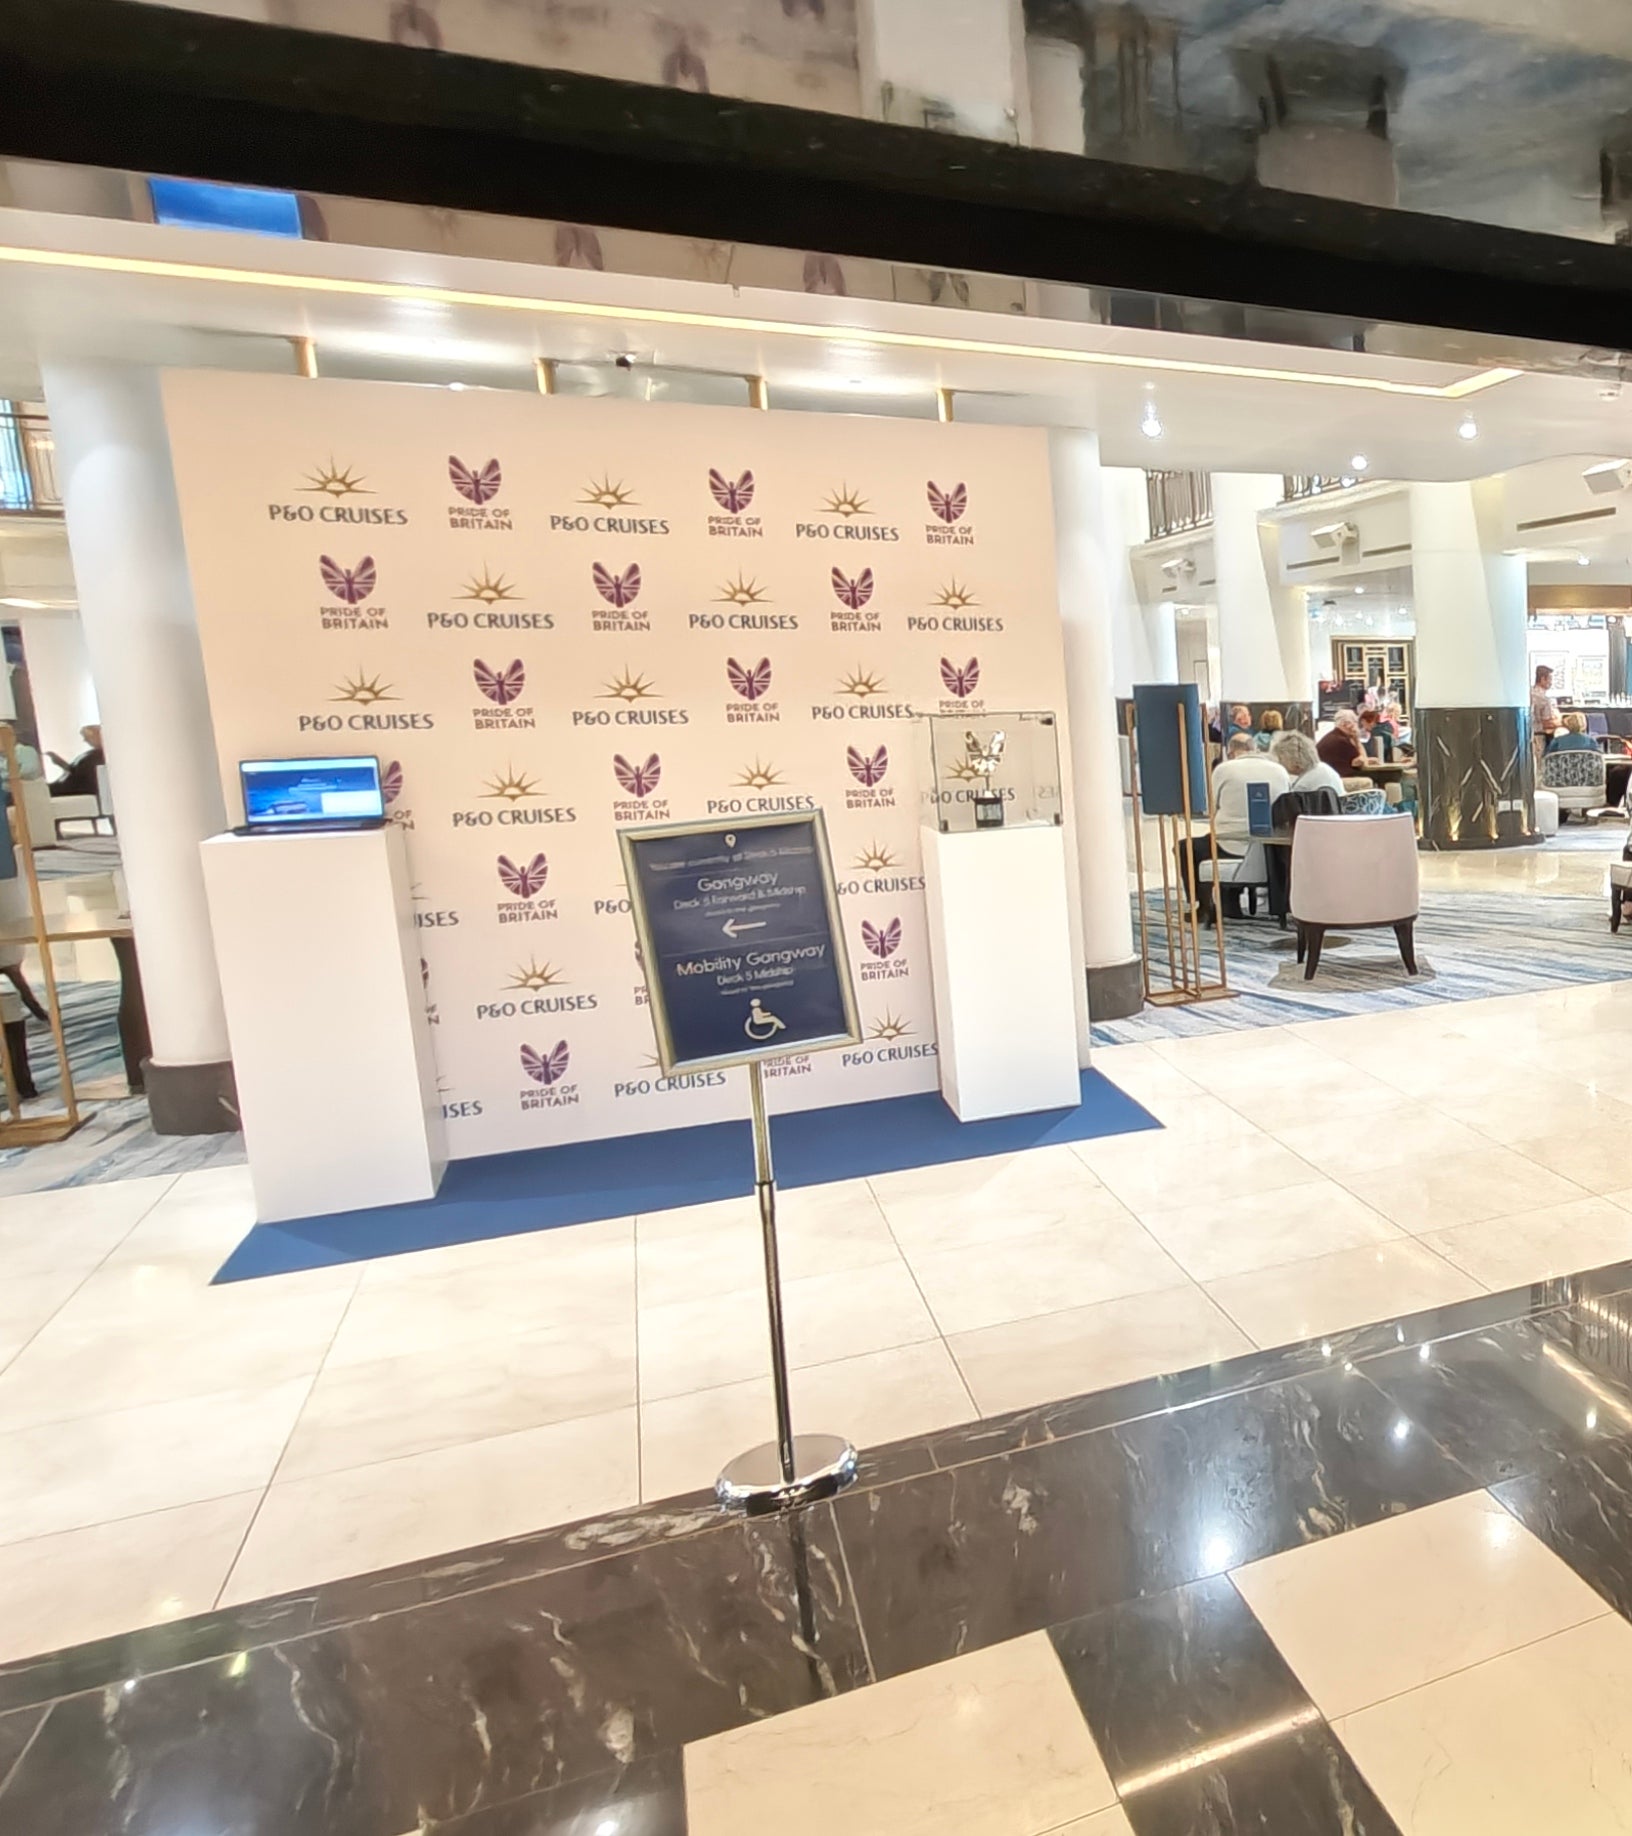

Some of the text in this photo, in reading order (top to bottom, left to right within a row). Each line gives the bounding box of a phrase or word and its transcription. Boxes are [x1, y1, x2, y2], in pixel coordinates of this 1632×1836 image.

[268, 504, 408, 526] P&O CRUISES
[448, 507, 510, 519] PRIDE OF
[449, 517, 513, 530] BRITAIN
[550, 515, 670, 535] P&O CRUISES
[708, 516, 761, 527] PRIDE OF
[708, 525, 763, 538] BRITAIN
[796, 523, 900, 542] P&O CRUISES
[926, 525, 972, 535] PRIDE OF
[926, 534, 974, 545] BRITAIN
[320, 607, 386, 617] PRIDE OF
[592, 610, 648, 620] PRIDE OF
[830, 612, 880, 623] PRIDE OF
[322, 617, 389, 630] BRITAIN
[427, 612, 555, 630] P&O CRUISES
[593, 620, 651, 632] BRITAIN
[689, 614, 799, 630] P&O CRUISES
[831, 621, 882, 632] BRITAIN
[907, 616, 1004, 633] P&O CRUISES
[726, 703, 778, 713] PRIDE OF
[939, 700, 984, 709] PRIDE OF
[472, 708, 534, 719] PRIDE OF
[572, 709, 689, 726] P&O CRUISES
[726, 712, 780, 724] BRITAIN
[811, 704, 914, 720] P&O CRUISES
[298, 713, 434, 732] P&O CRUISES
[474, 718, 536, 730] BRITAIN
[845, 788, 895, 798] PRIDE OF
[613, 799, 668, 811] PRIDE OF
[707, 796, 815, 814] P&O CRUISES
[846, 797, 896, 809] BRITAIN
[452, 808, 576, 827] P&O CRUISES
[614, 809, 670, 821] BRITAIN
[697, 871, 779, 892] Gangway
[863, 877, 926, 893] CRUISES
[498, 900, 556, 914] PRIDE OF
[594, 899, 632, 915] P&O
[498, 910, 558, 924] BRITAIN
[676, 944, 826, 976] Mobility Gangway
[860, 959, 907, 970] PRIDE OF
[861, 968, 909, 981] BRITAIN
[476, 995, 598, 1020] P&O CRUISES
[842, 1043, 938, 1067] P&O CRUISES
[614, 1071, 726, 1097] P&O CRUISES
[520, 1084, 577, 1099] PRIDE OF
[521, 1094, 579, 1110] BRITAIN
